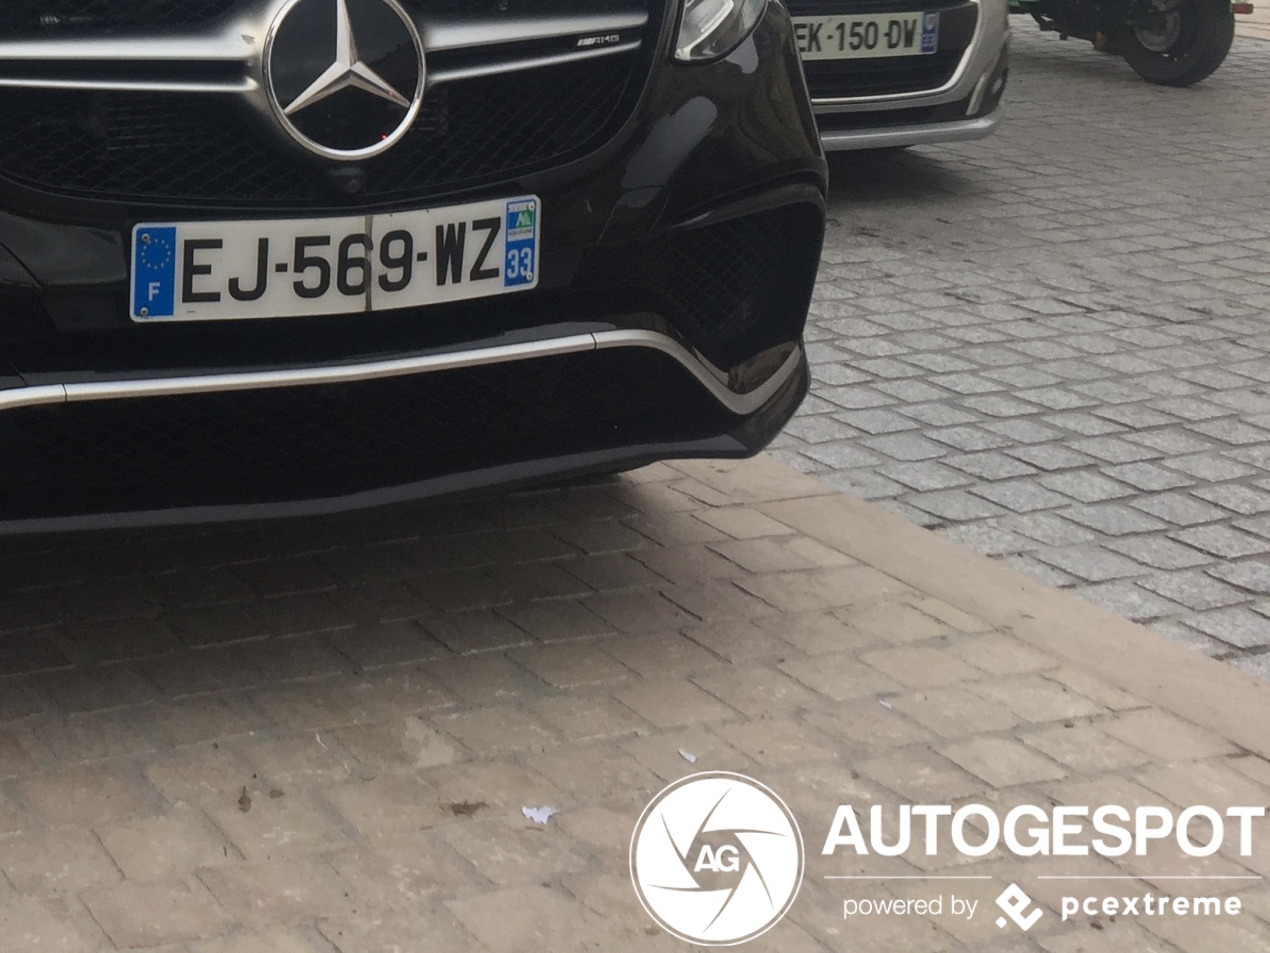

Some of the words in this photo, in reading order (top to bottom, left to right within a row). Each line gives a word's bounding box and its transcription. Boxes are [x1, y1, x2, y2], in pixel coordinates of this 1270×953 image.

[182, 217, 501, 303] EJ-569-WZ
[507, 247, 532, 279] 33
[148, 282, 161, 302] F
